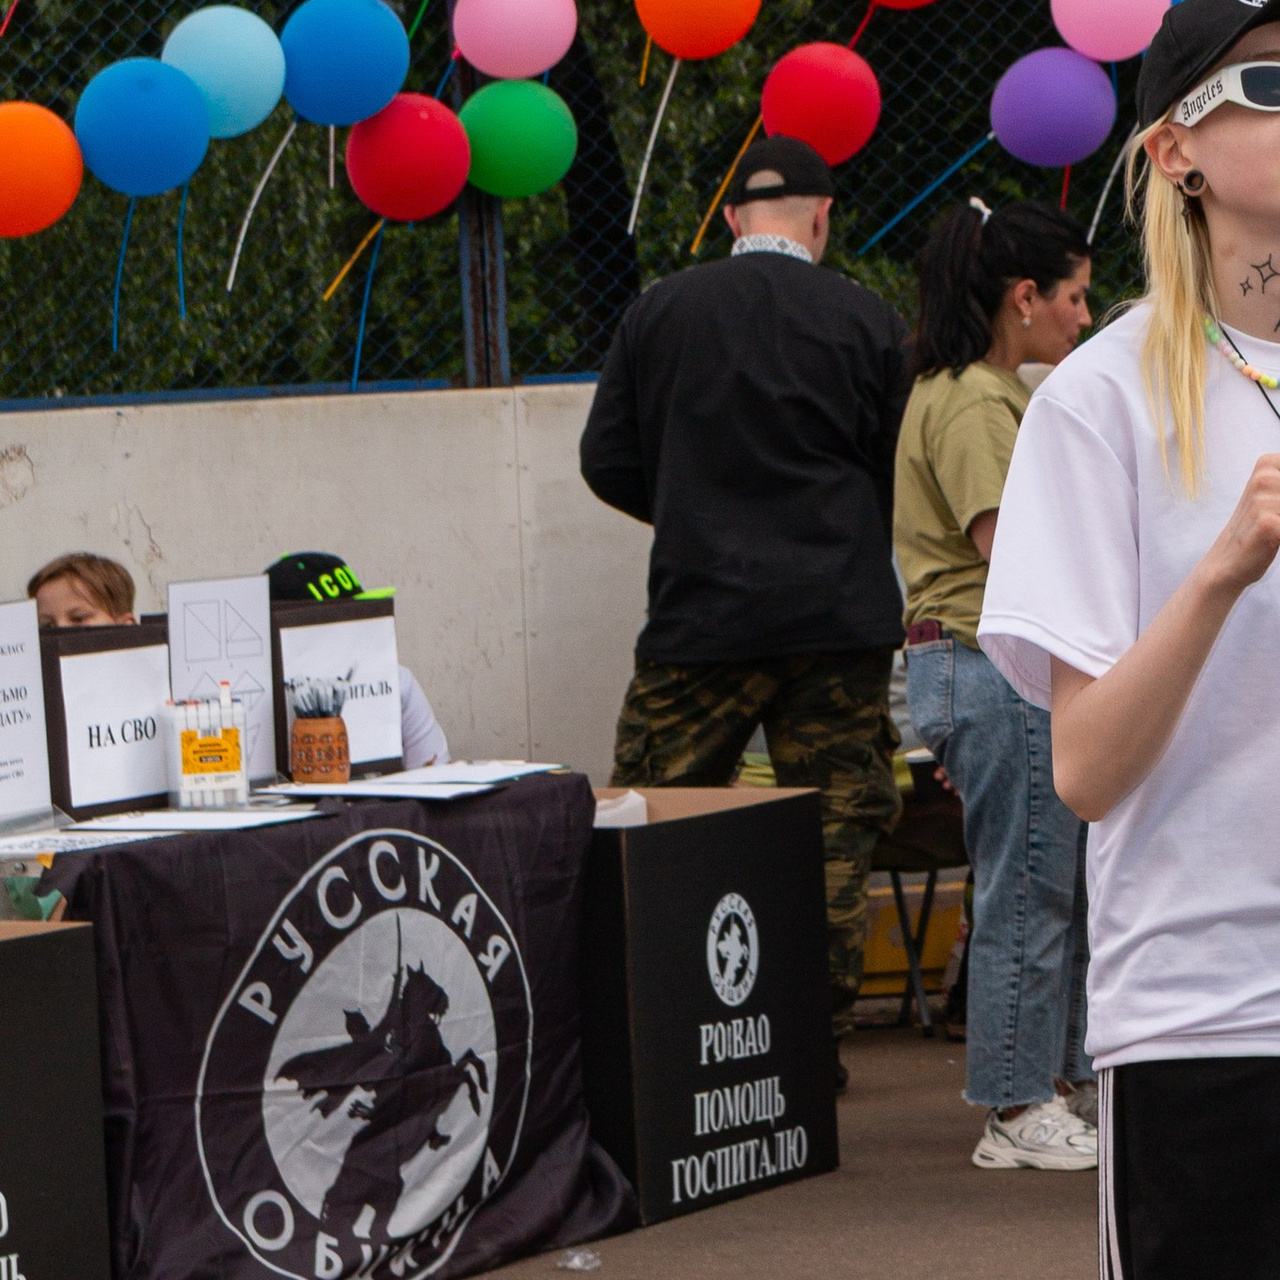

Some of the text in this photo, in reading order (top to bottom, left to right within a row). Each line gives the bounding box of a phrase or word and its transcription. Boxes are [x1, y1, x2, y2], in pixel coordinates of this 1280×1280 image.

[1181, 77, 1223, 122] Angeles
[349, 680, 393, 700] ИТАЛЬ
[88, 716, 156, 748] НА СВО
[238, 840, 511, 1026] РУССКАЯ
[694, 1076, 785, 1136] ПОМОЩЬ
[671, 1125, 808, 1203] ГОСПИТАЛЮ
